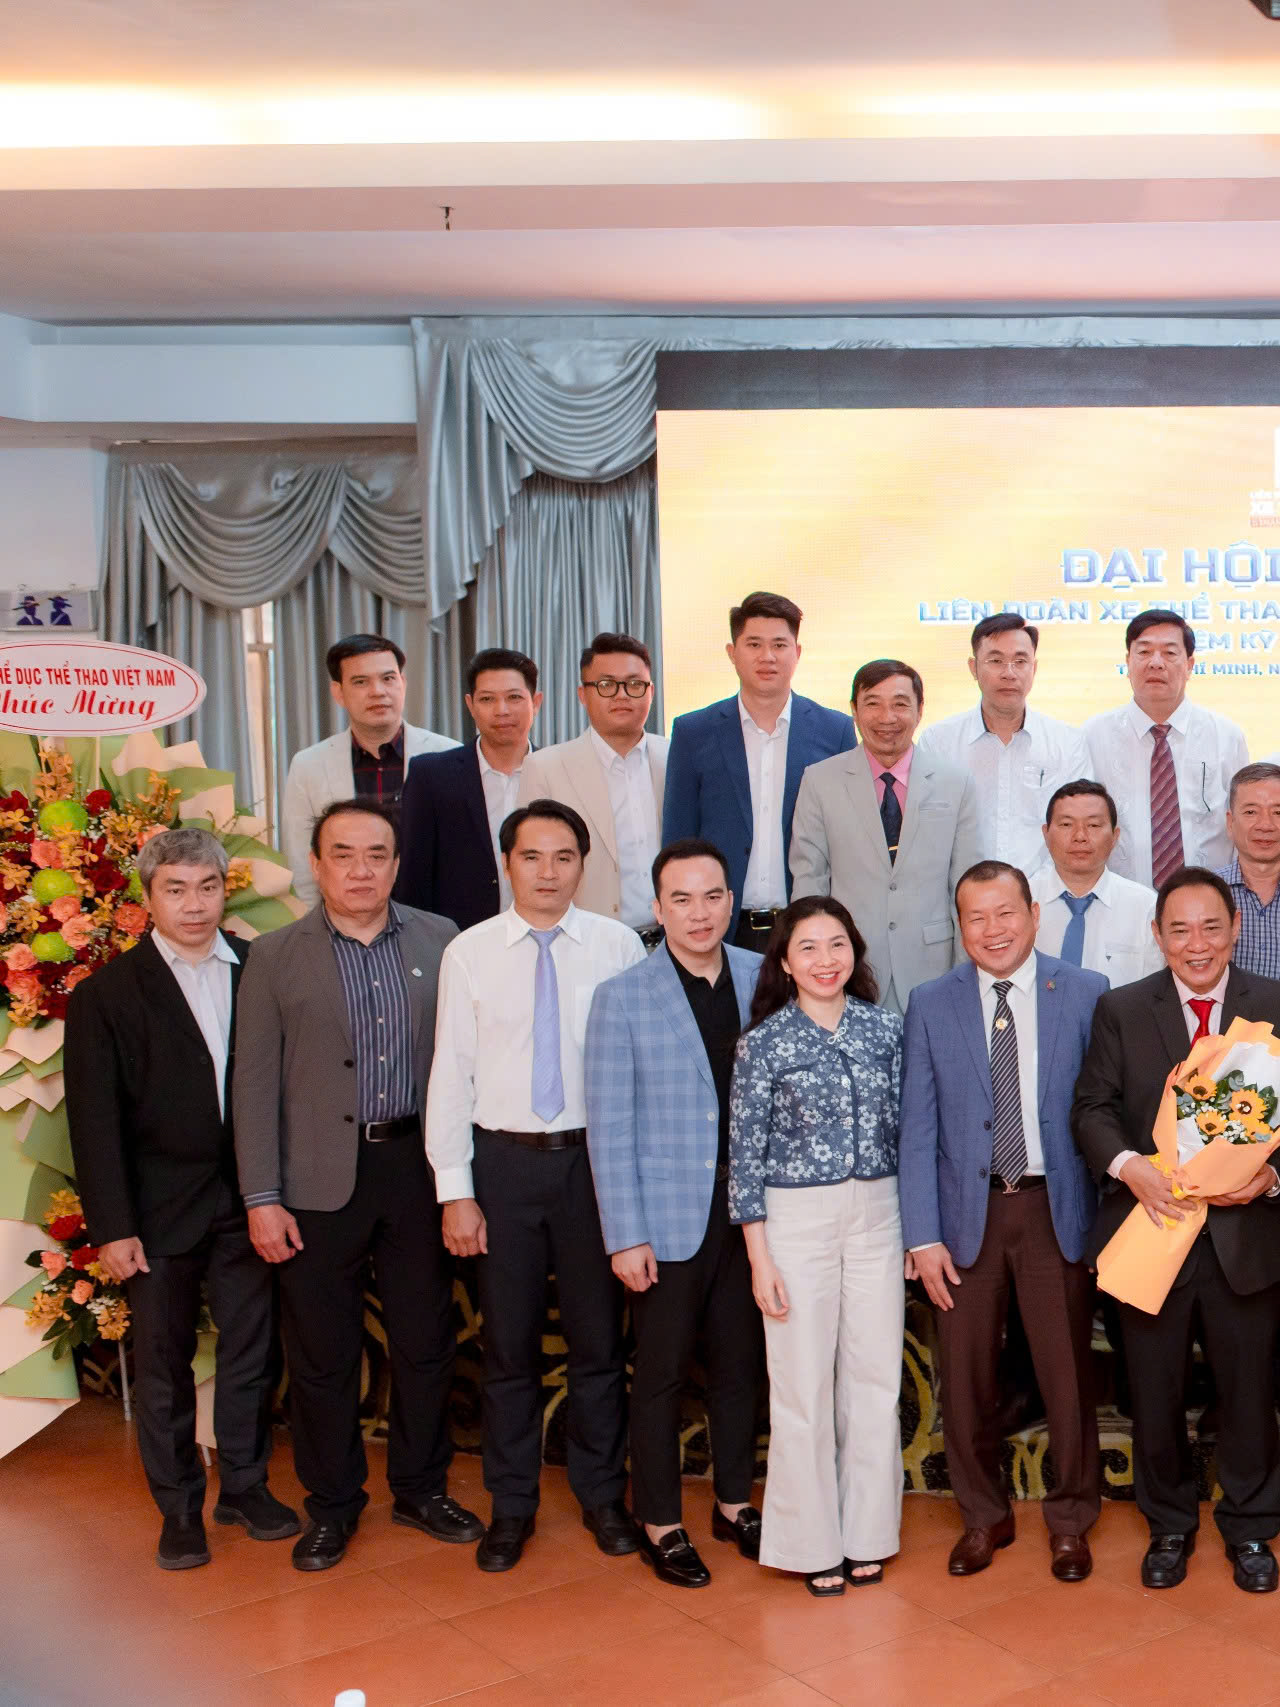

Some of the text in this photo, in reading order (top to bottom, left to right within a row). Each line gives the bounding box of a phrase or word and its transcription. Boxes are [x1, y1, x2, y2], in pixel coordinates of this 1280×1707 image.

[1060, 548, 1165, 588] ĐẠI
[919, 598, 992, 621] LIÊN
[1099, 599, 1140, 621] XE
[15, 667, 42, 689] DỤC
[45, 660, 72, 685] THỂ
[74, 668, 108, 686] THAO
[112, 665, 141, 690] VIỆT
[145, 669, 176, 686] NAM
[1212, 663, 1262, 676] MINH,
[0, 689, 158, 721] húc Mừng
